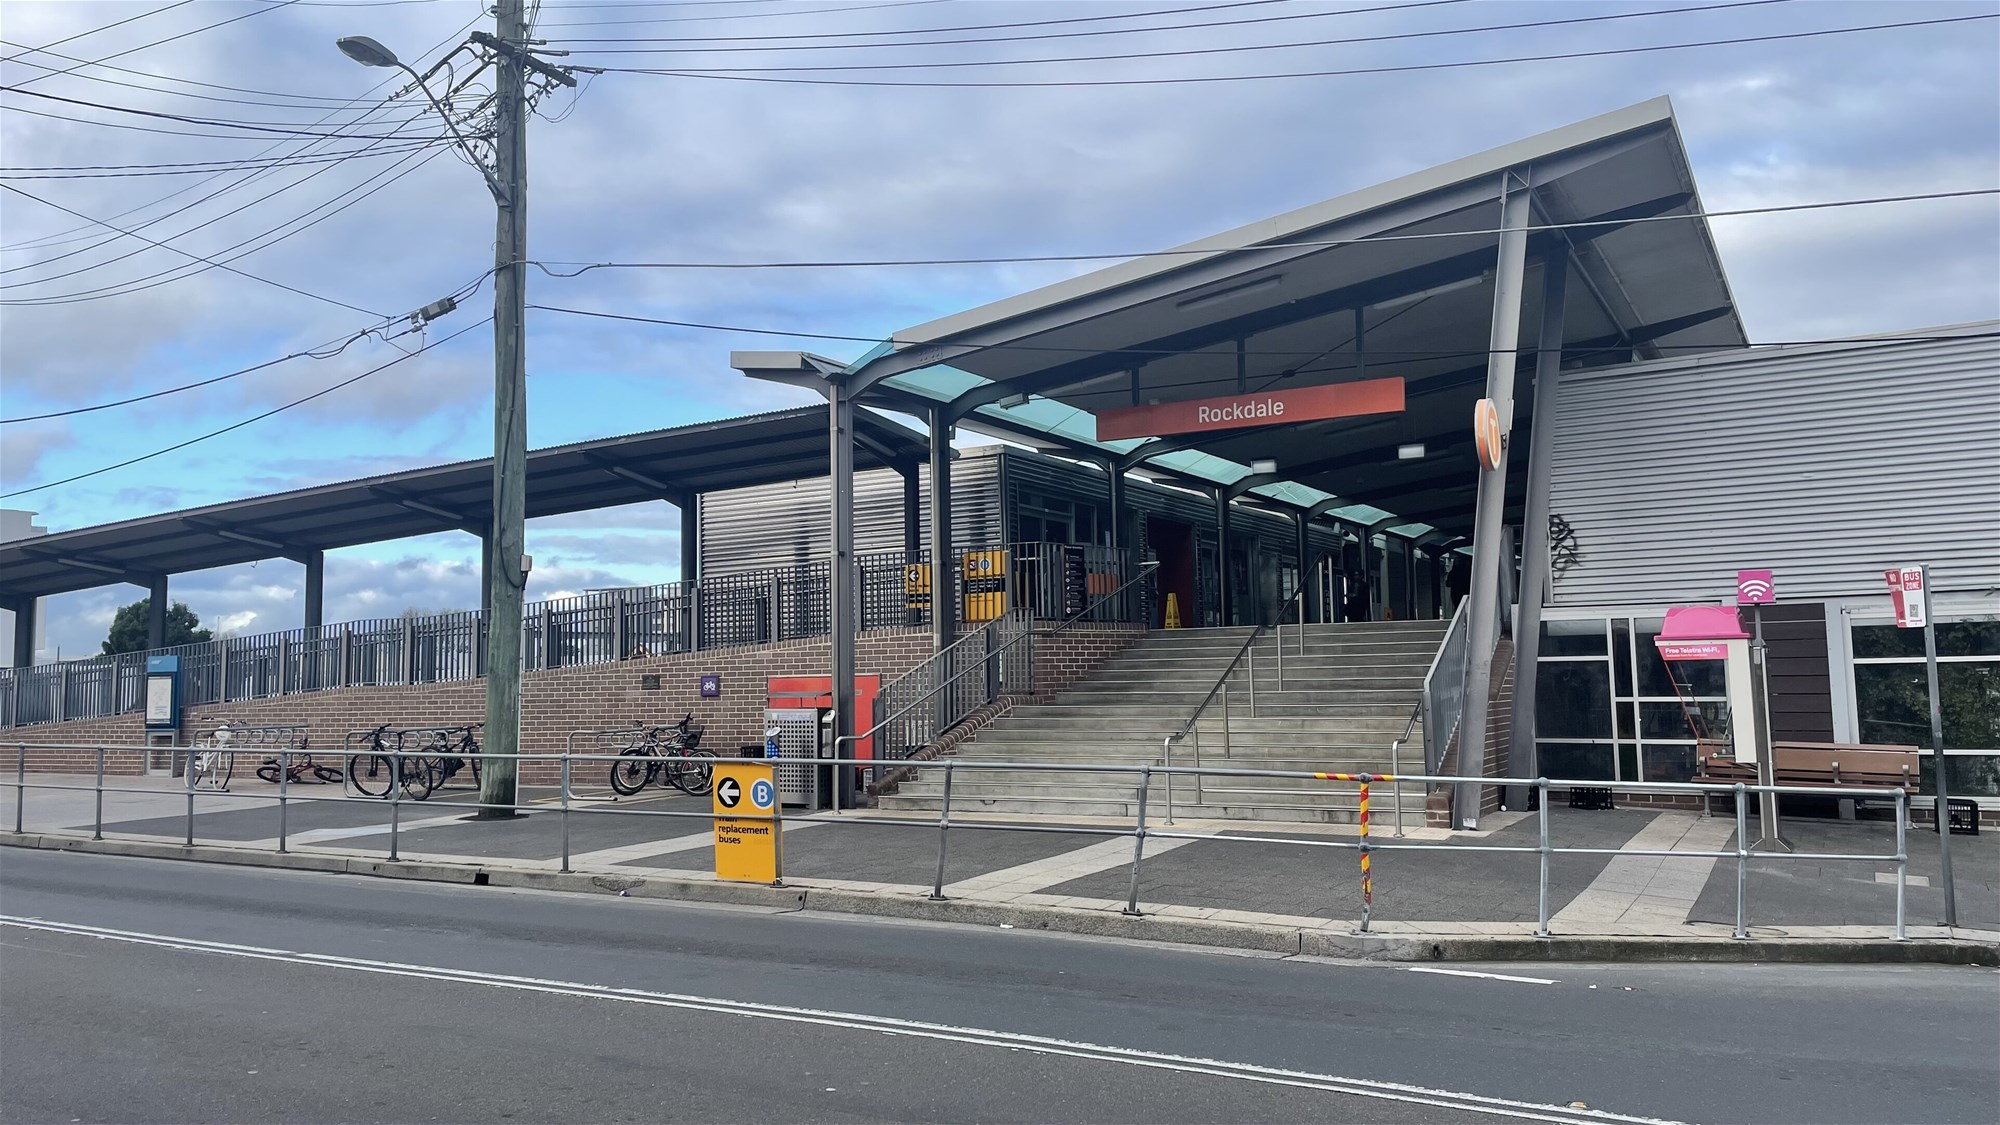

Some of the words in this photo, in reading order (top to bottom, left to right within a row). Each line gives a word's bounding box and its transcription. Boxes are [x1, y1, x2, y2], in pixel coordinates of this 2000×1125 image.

[1198, 398, 1285, 424] Rockdale
[1489, 417, 1497, 455] T
[1904, 572, 1920, 582] BUS
[1905, 582, 1920, 590] ZONE
[757, 785, 769, 803] B
[718, 824, 769, 835] replacement
[718, 834, 741, 844] buses
